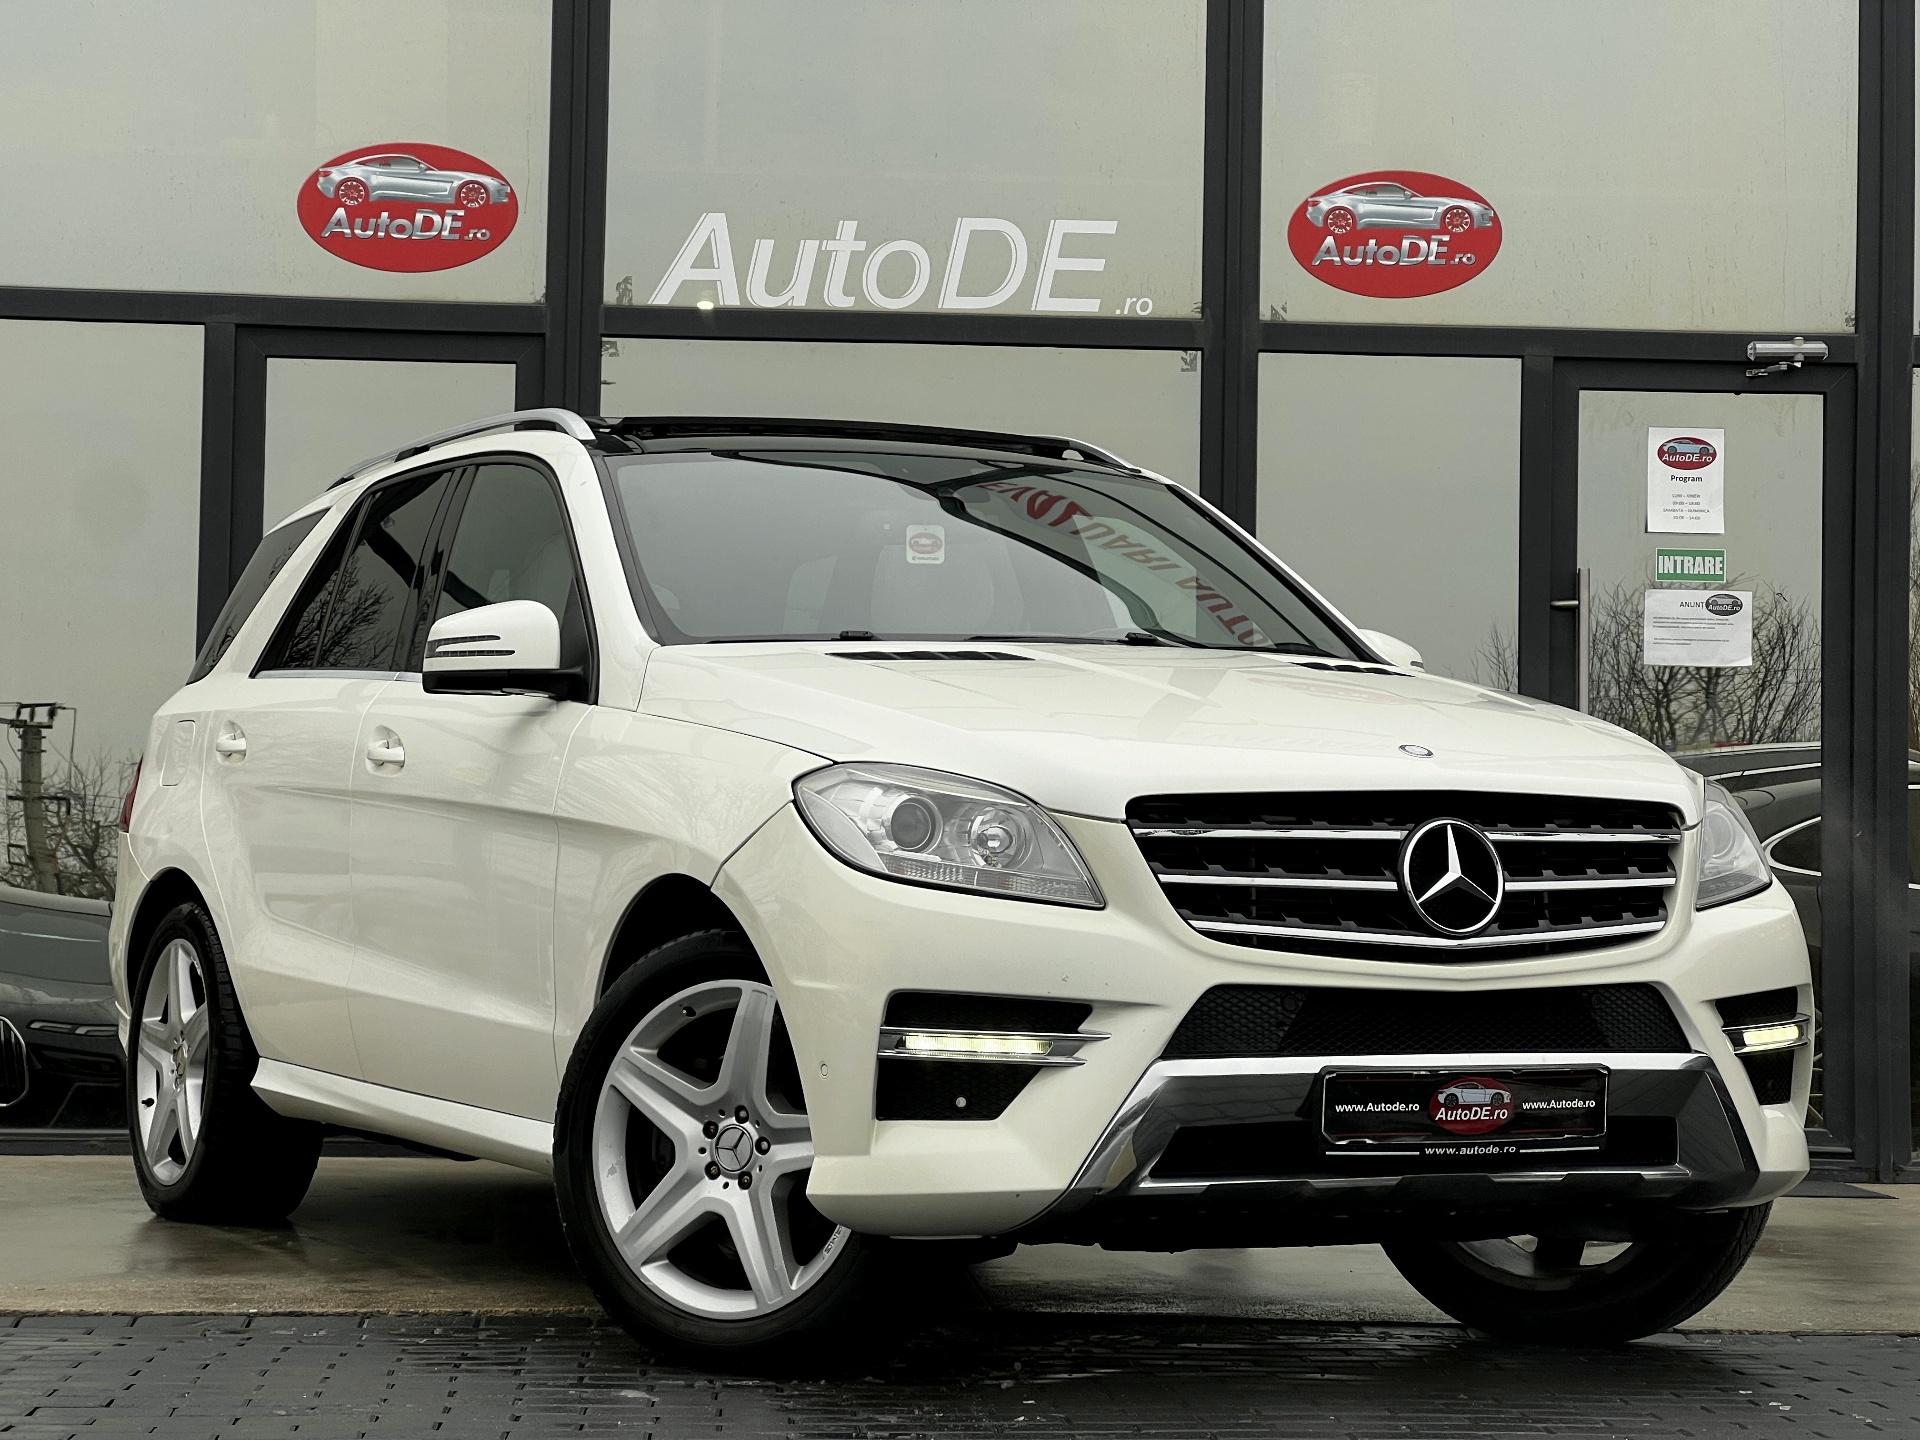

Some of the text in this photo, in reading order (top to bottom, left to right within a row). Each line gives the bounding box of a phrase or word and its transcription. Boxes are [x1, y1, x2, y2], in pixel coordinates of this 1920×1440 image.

[1661, 453, 1713, 463] AutoDE.ro
[1670, 474, 1703, 483] Program
[1658, 555, 1723, 575] INTRARE
[1335, 1101, 1420, 1113] www.Autode.ro
[1522, 1098, 1596, 1111] www.Autode.ro
[1434, 1106, 1509, 1122] AutoDE.ro
[1424, 1144, 1517, 1156] www.autode.ro
